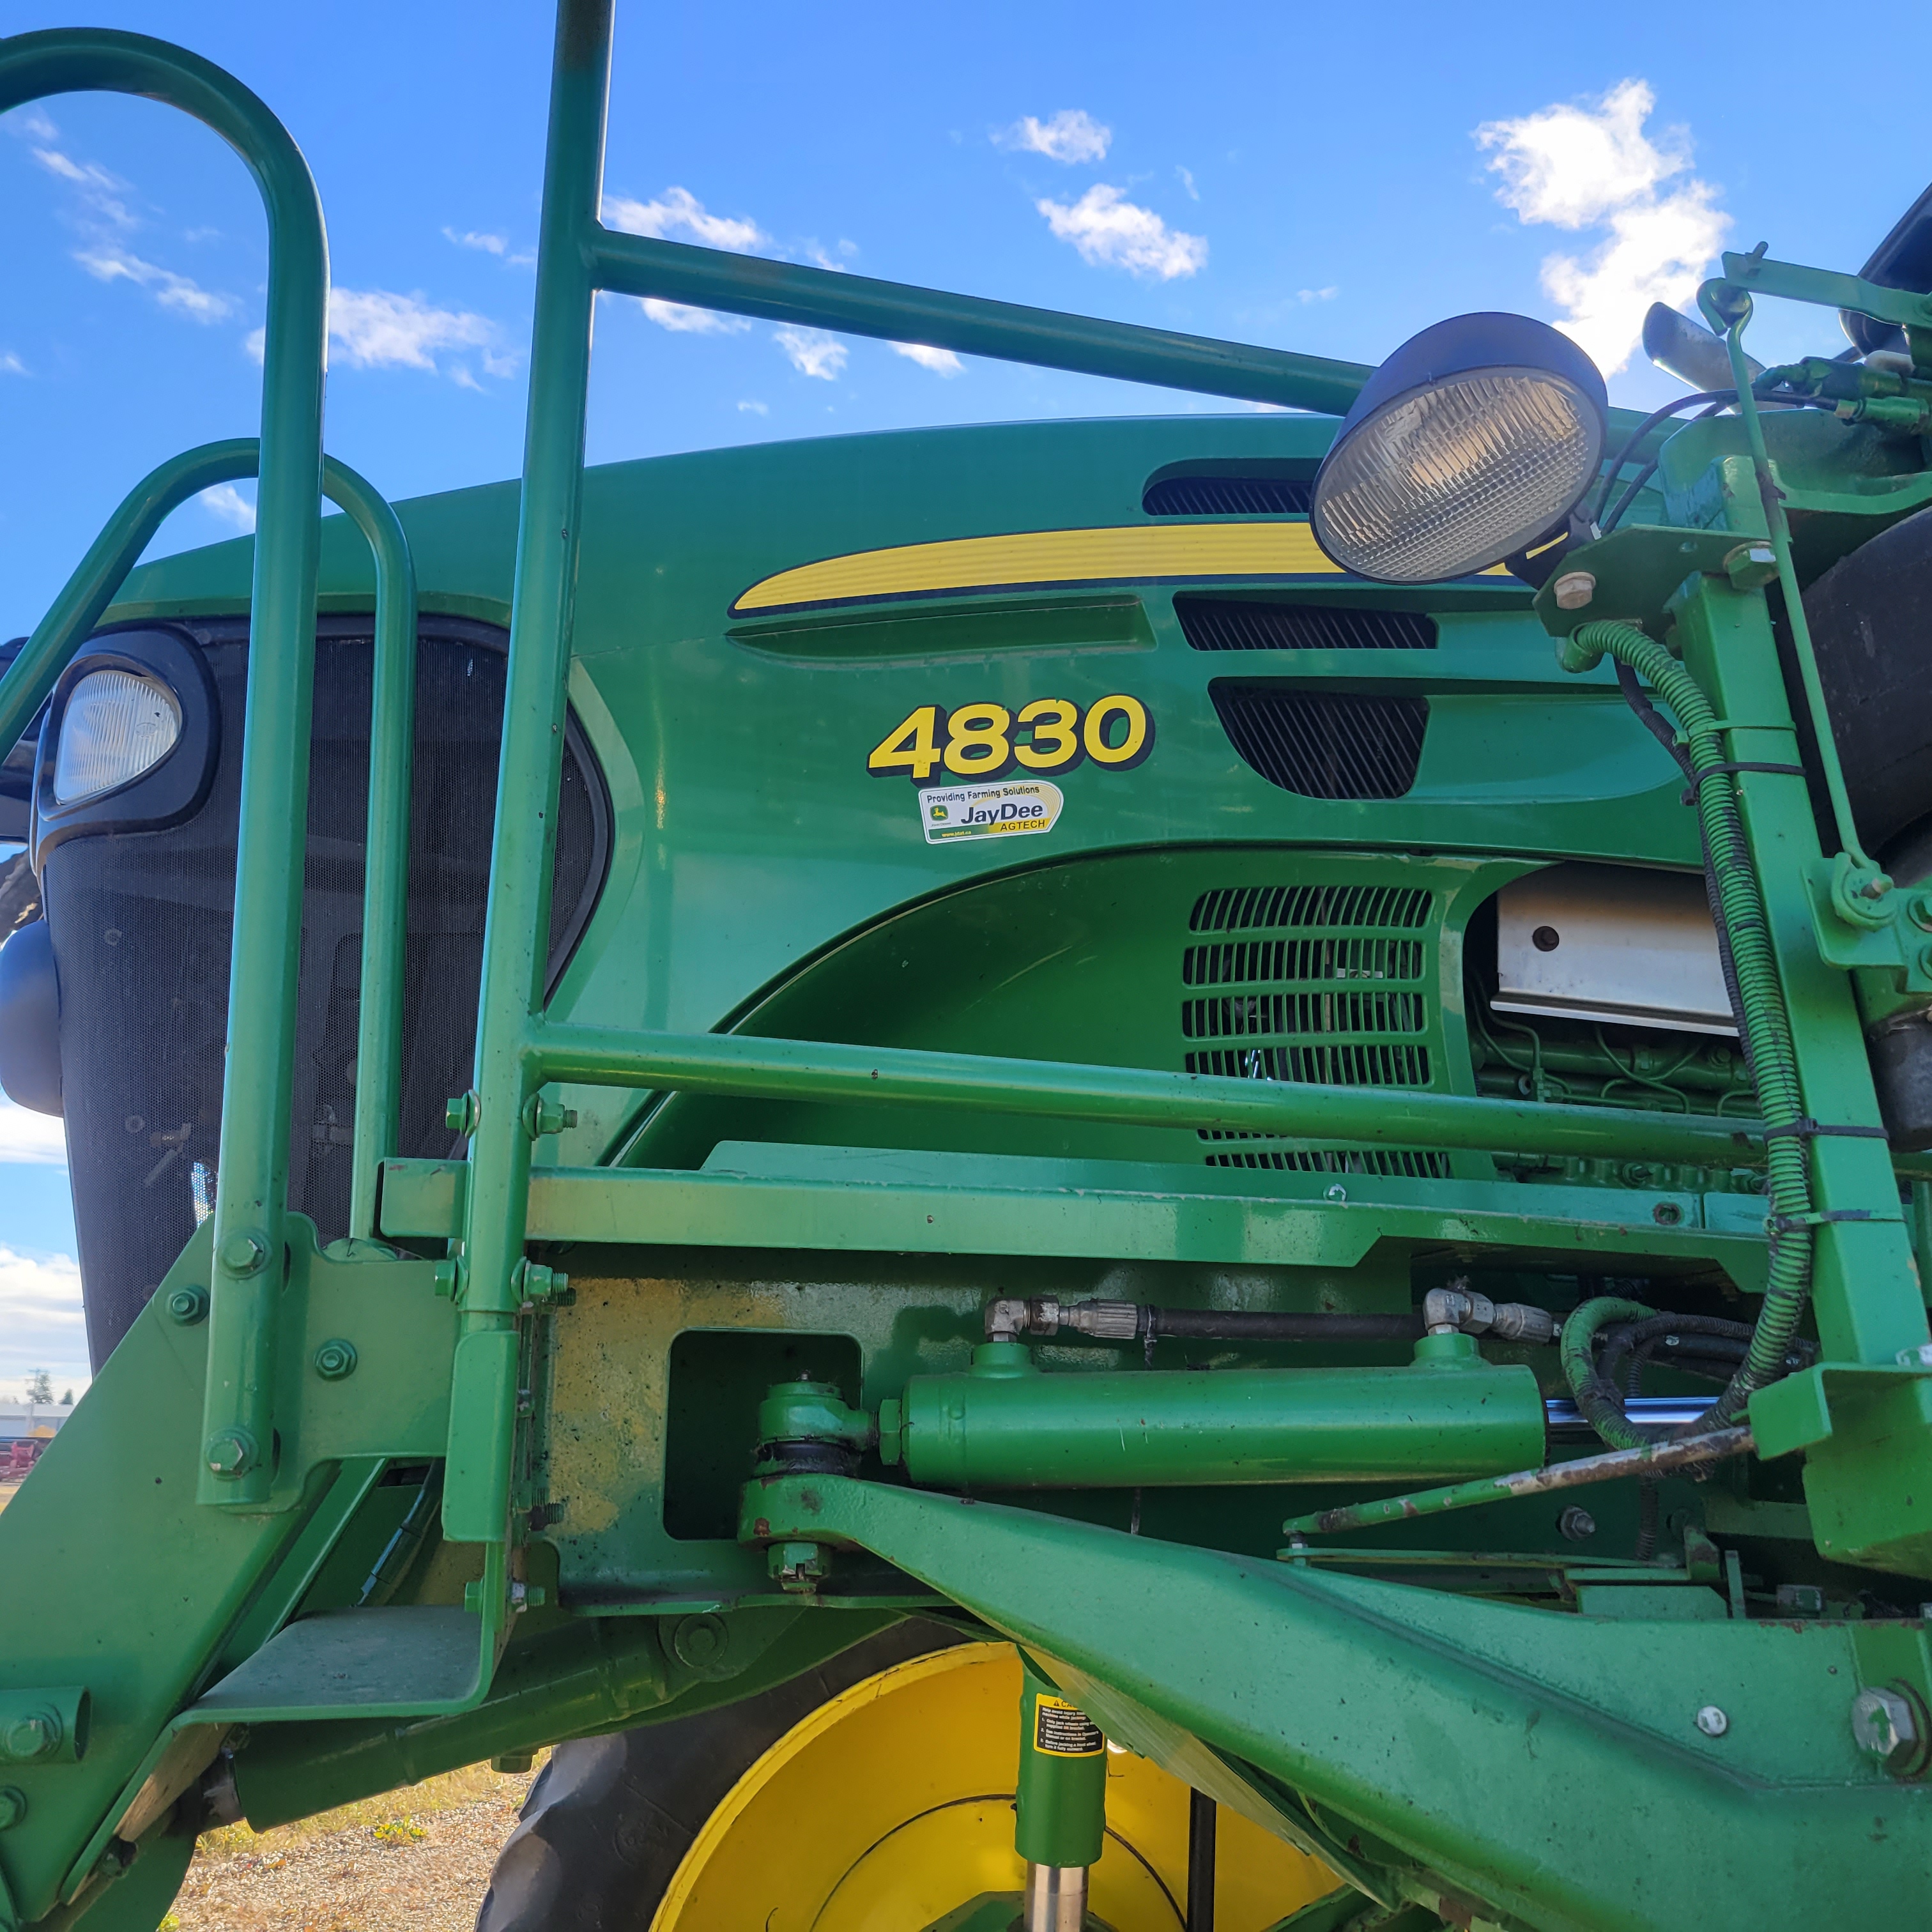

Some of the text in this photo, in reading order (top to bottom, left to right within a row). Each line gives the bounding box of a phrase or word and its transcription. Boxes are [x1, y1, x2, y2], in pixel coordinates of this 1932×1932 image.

[867, 694, 1152, 785] 4830
[927, 786, 1040, 804] Providing Farming Solutions
[960, 803, 1043, 825] JayDee
[1000, 820, 1045, 832] AGTECH
